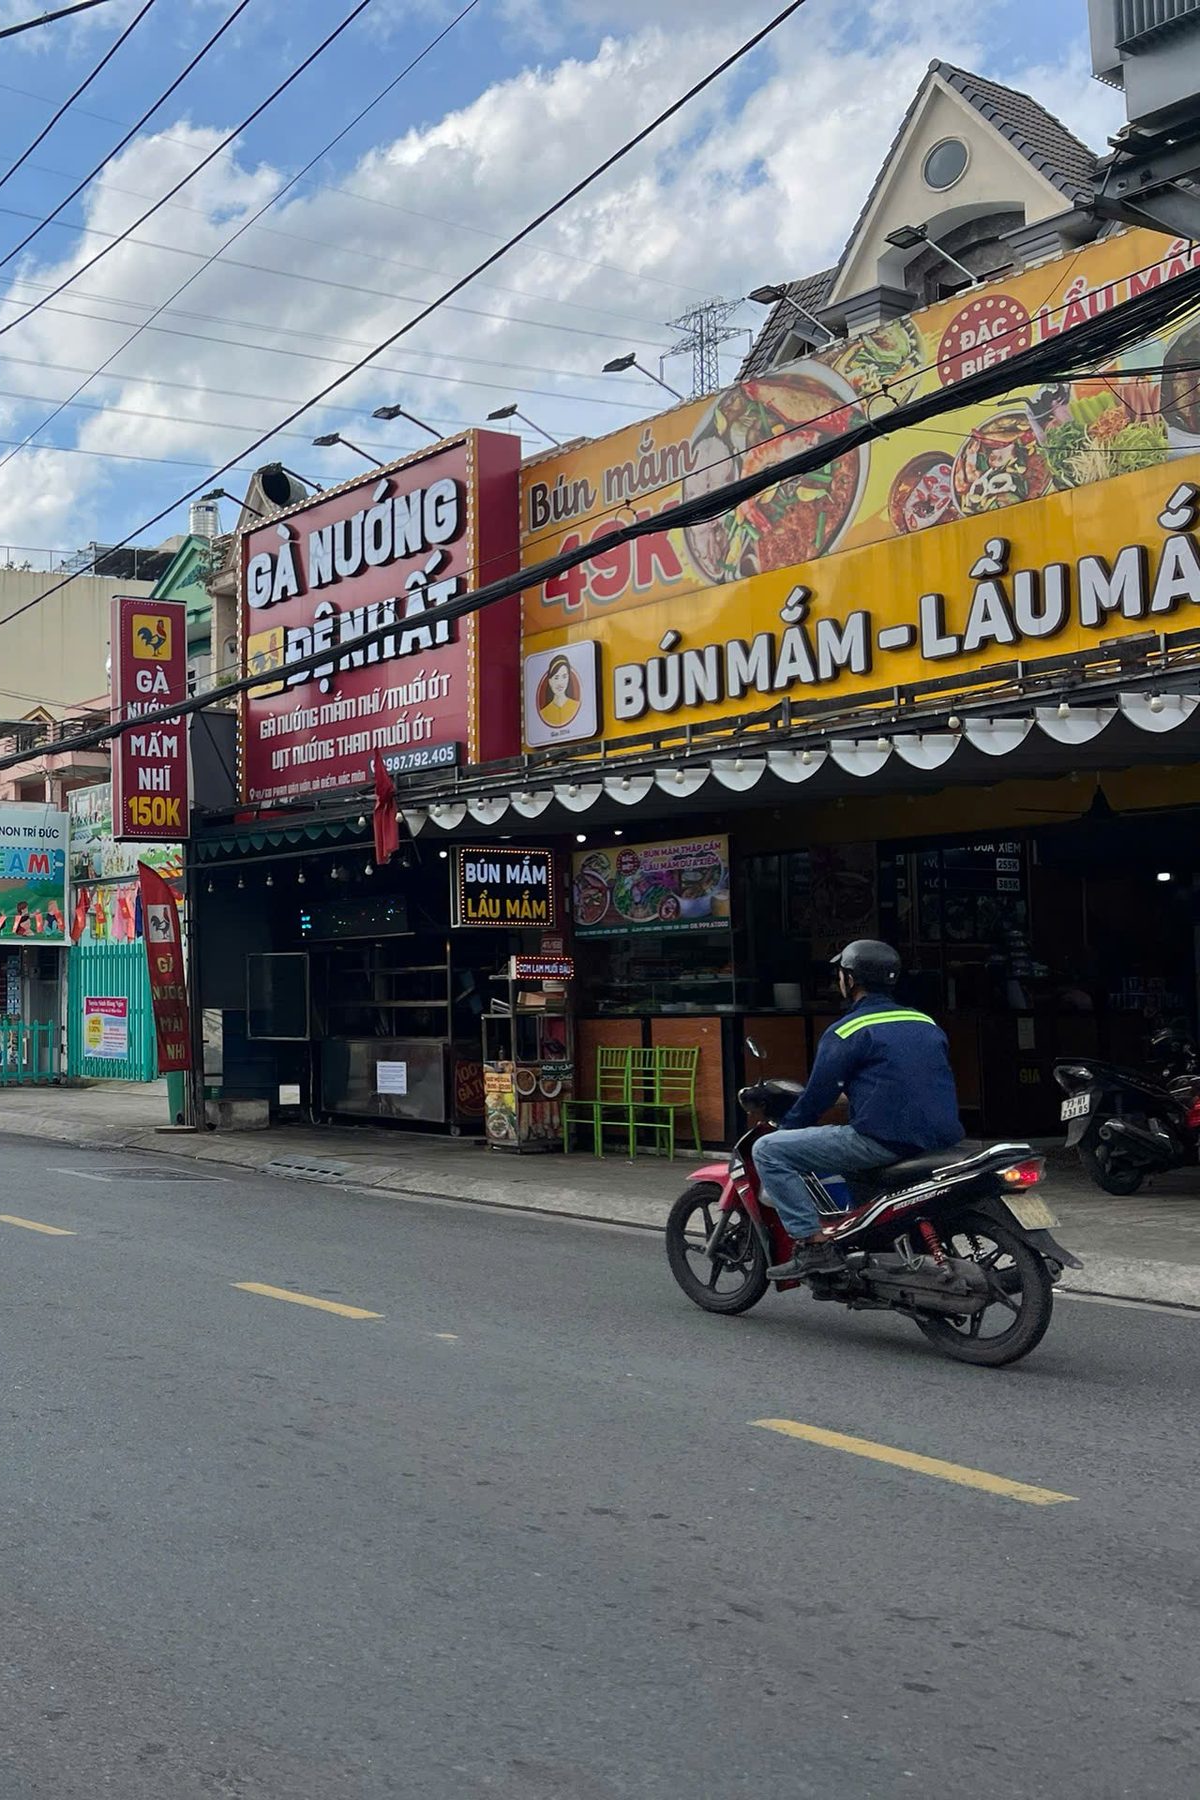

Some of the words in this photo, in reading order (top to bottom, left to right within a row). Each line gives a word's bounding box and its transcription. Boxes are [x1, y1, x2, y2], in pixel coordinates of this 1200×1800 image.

[1039, 279, 1114, 340] LẨU
[1130, 240, 1200, 300] MẮ
[960, 317, 1008, 350] ĐẶC
[961, 345, 1011, 379] BIỆT
[529, 474, 597, 531] Bún
[605, 428, 698, 504] mắm
[247, 524, 299, 609] GÀ
[309, 478, 458, 588] NƯỚNG
[543, 500, 684, 606] 49K
[285, 601, 334, 693] ĐỆ
[339, 550, 457, 671] NHẤT
[614, 630, 719, 721] BÚN
[726, 585, 871, 698] MẮM
[920, 538, 1068, 660] LẨU
[136, 665, 170, 694] GÀ
[260, 712, 276, 739] GÀ
[277, 705, 319, 734] NƯỚNG
[428, 669, 451, 698] ỚT
[130, 731, 178, 758] MẮM
[272, 747, 290, 772] VỊT
[292, 735, 335, 765] NƯỚNG
[336, 731, 370, 755] THAN
[372, 711, 410, 749] MUỐI
[412, 712, 435, 741] ỚT
[138, 765, 171, 791] NHĨ
[128, 795, 182, 827] 150K
[0, 826, 20, 837] NON
[22, 825, 36, 837] TRÍ
[38, 825, 60, 838] ĐỨC
[465, 858, 500, 883] BÚN
[506, 855, 547, 884] MẮM
[467, 889, 500, 918] LẨU
[506, 890, 547, 919] MẮM
